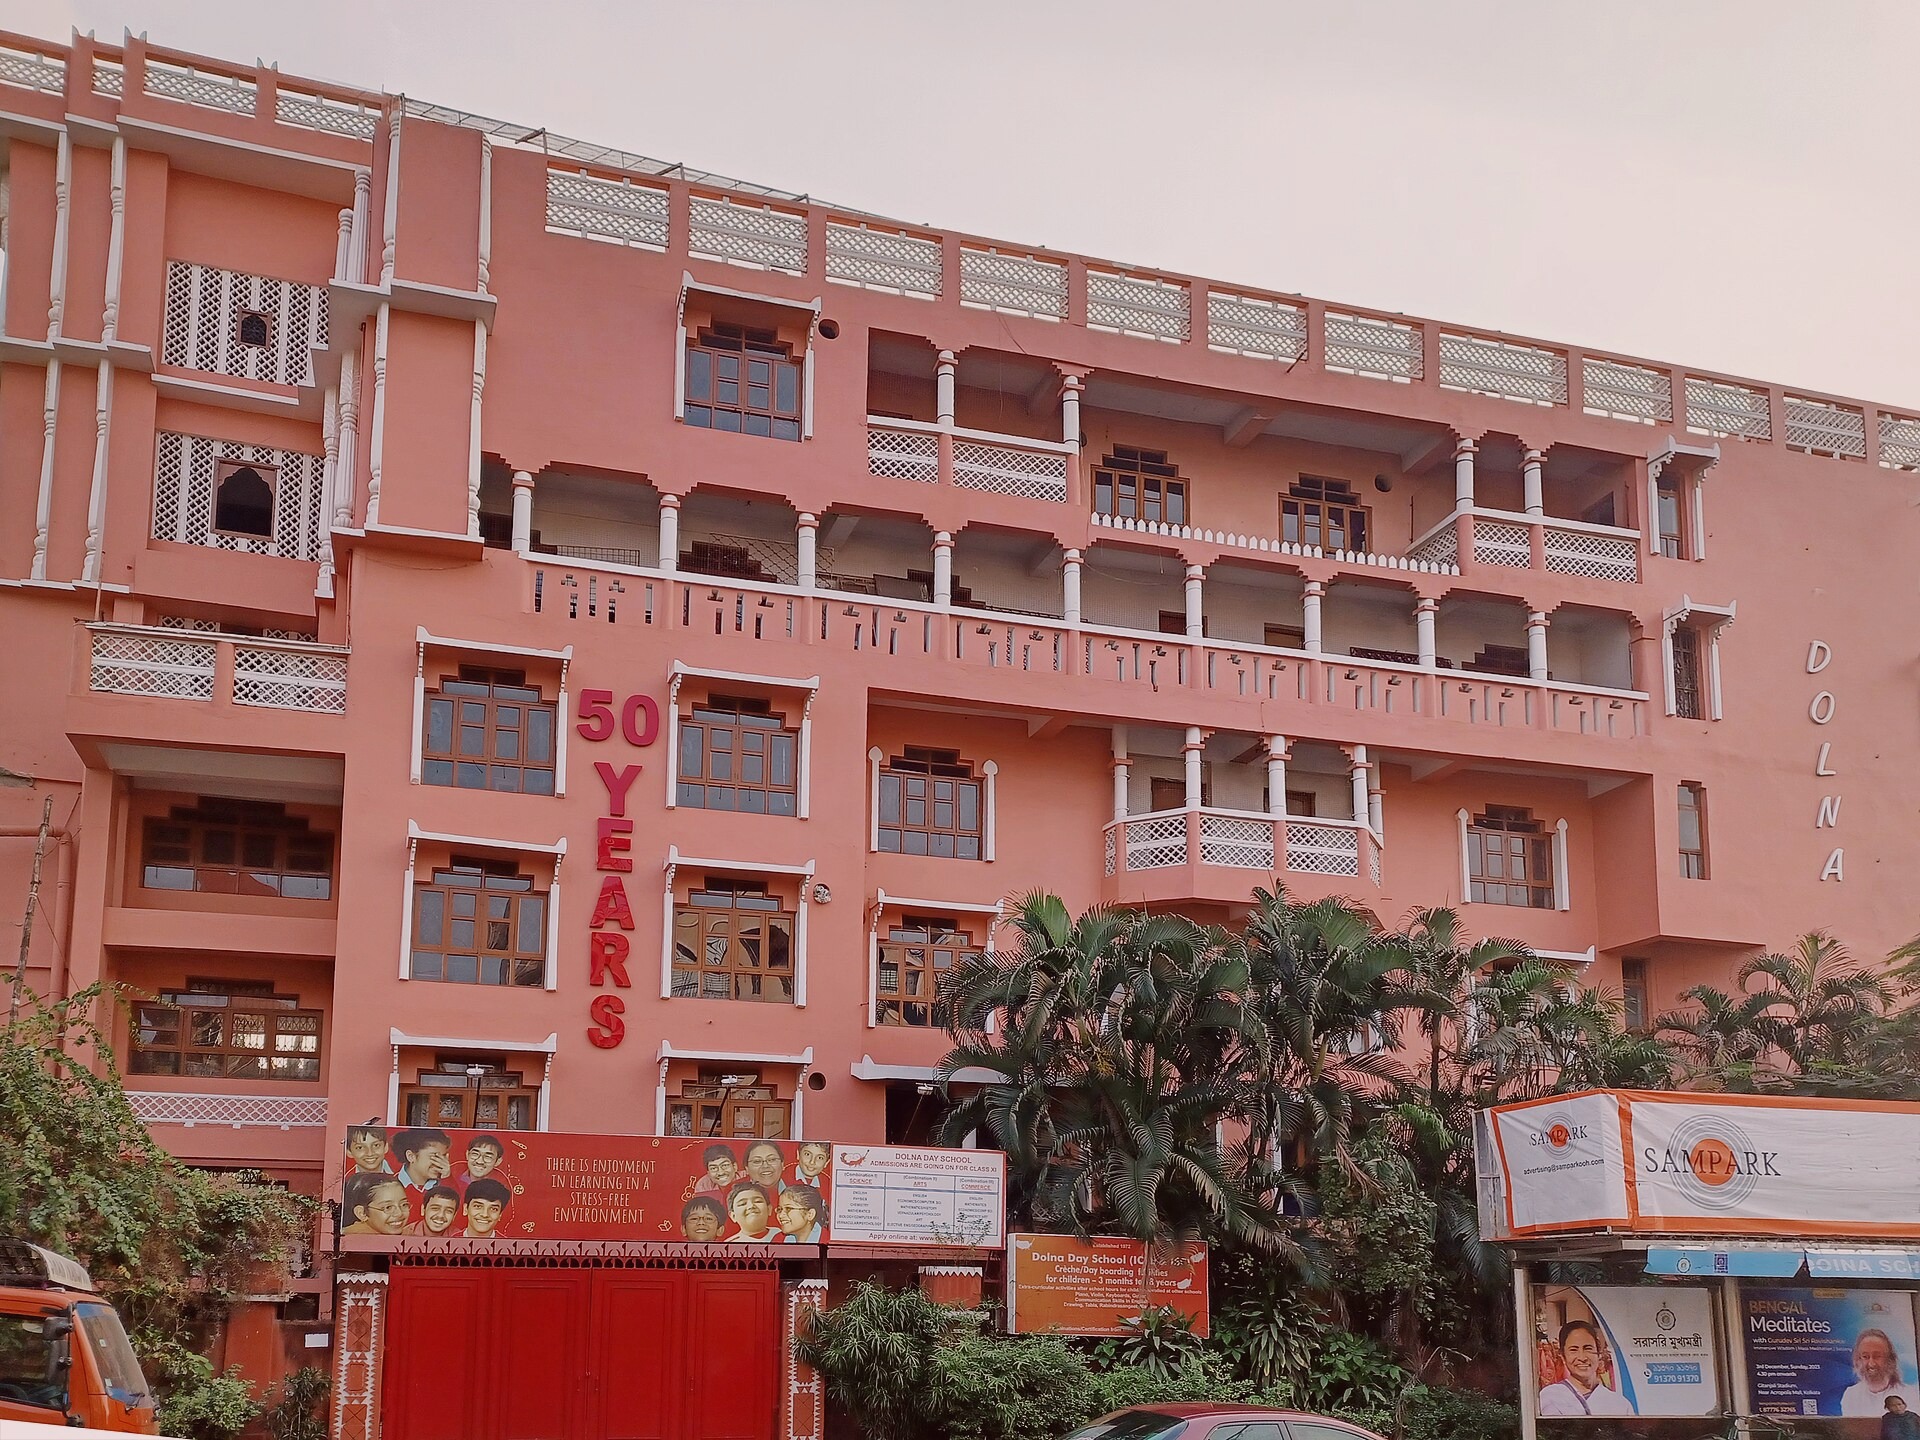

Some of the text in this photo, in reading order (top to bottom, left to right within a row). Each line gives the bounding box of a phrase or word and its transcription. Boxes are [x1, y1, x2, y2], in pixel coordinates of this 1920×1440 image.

[576, 688, 660, 747] 50
[1806, 639, 1844, 882] DOLNA
[586, 761, 643, 1049] YEARS
[1530, 1125, 1588, 1147] SAMPARK
[546, 1157, 656, 1174] THERE IS ENJOYMENT
[895, 1153, 922, 1161] DOLNA
[940, 1156, 972, 1164] SCHOOL
[1523, 1157, 1605, 1176] advertising@samparkooh.com
[1644, 1147, 1781, 1177] SAMPARK
[551, 1174, 650, 1190] IN LEARNING IN A
[570, 1192, 630, 1206] STRESS-FREE
[554, 1207, 644, 1224] ENVIRONMENT
[868, 1232, 888, 1240] Apply
[1032, 1252, 1064, 1262] Dolna
[1068, 1254, 1088, 1264] Day
[1092, 1254, 1126, 1264] School
[1055, 1264, 1098, 1276] Crèche/Day
[1100, 1266, 1134, 1277] boarding
[1046, 1274, 1057, 1282] for
[1059, 1274, 1090, 1284] children
[1105, 1276, 1133, 1285] months
[1135, 1278, 1142, 1286] to
[1156, 1280, 1177, 1288] years
[1750, 1300, 1807, 1314] BENGAL
[1750, 1316, 1831, 1333] Meditates
[1632, 1333, 1702, 1350] সরাসরি মুখ্যমন্ত্রী
[1654, 1374, 1699, 1382] 91370 91370
